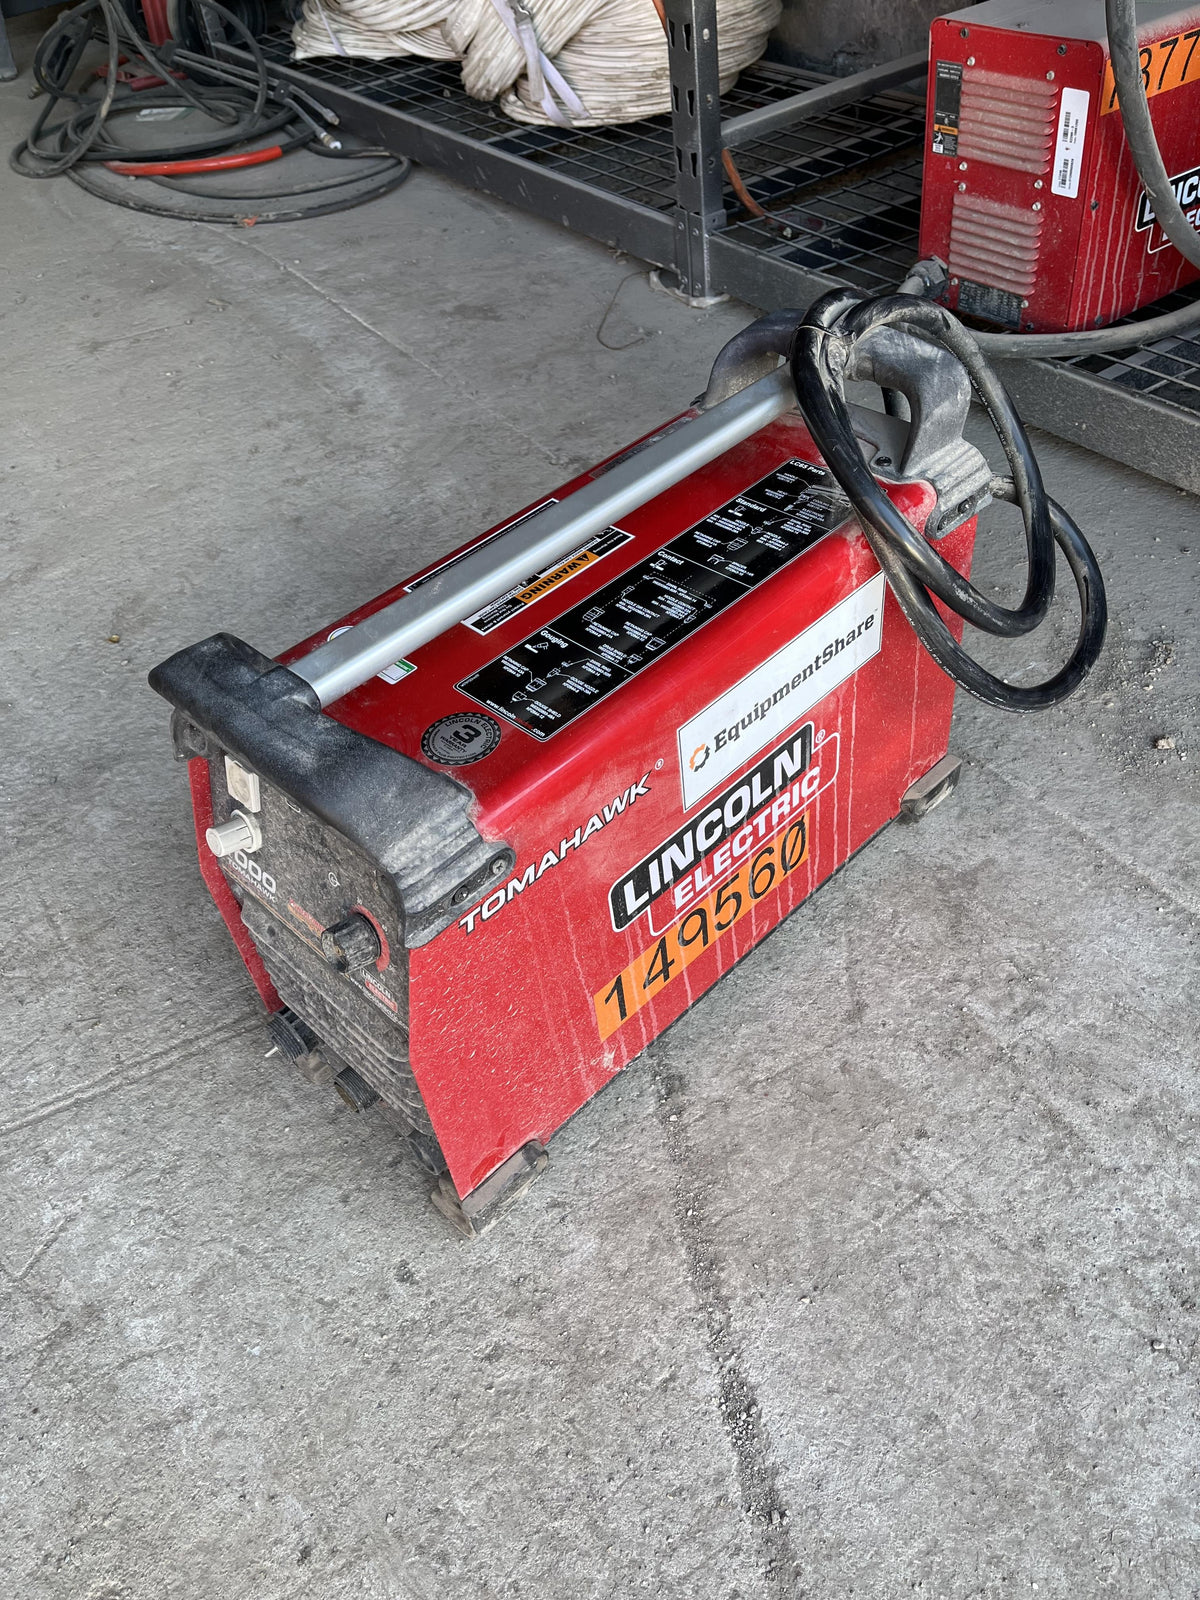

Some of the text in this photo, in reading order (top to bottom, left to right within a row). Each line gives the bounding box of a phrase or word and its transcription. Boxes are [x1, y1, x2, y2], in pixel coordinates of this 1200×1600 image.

[808, 464, 826, 477] Parts
[735, 497, 767, 513] Standard
[657, 550, 685, 566] Contact
[520, 561, 581, 600] WARNING
[540, 630, 569, 649] Gouging
[714, 614, 874, 753] EquipmentShare
[440, 735, 467, 754] WARRANTY
[445, 716, 481, 728] LINCOLN
[480, 721, 494, 750] ELECTRIC
[449, 734, 468, 749] YEAR
[453, 724, 482, 744] 3
[623, 737, 802, 917] LINCOLN
[674, 765, 821, 910] ELECTRIC
[458, 769, 652, 936] TOMAHAWK
[227, 857, 278, 903] TOMAHAWK
[228, 848, 277, 894] 000
[604, 815, 807, 1022] 149560
[362, 969, 391, 999] LINCOLN
